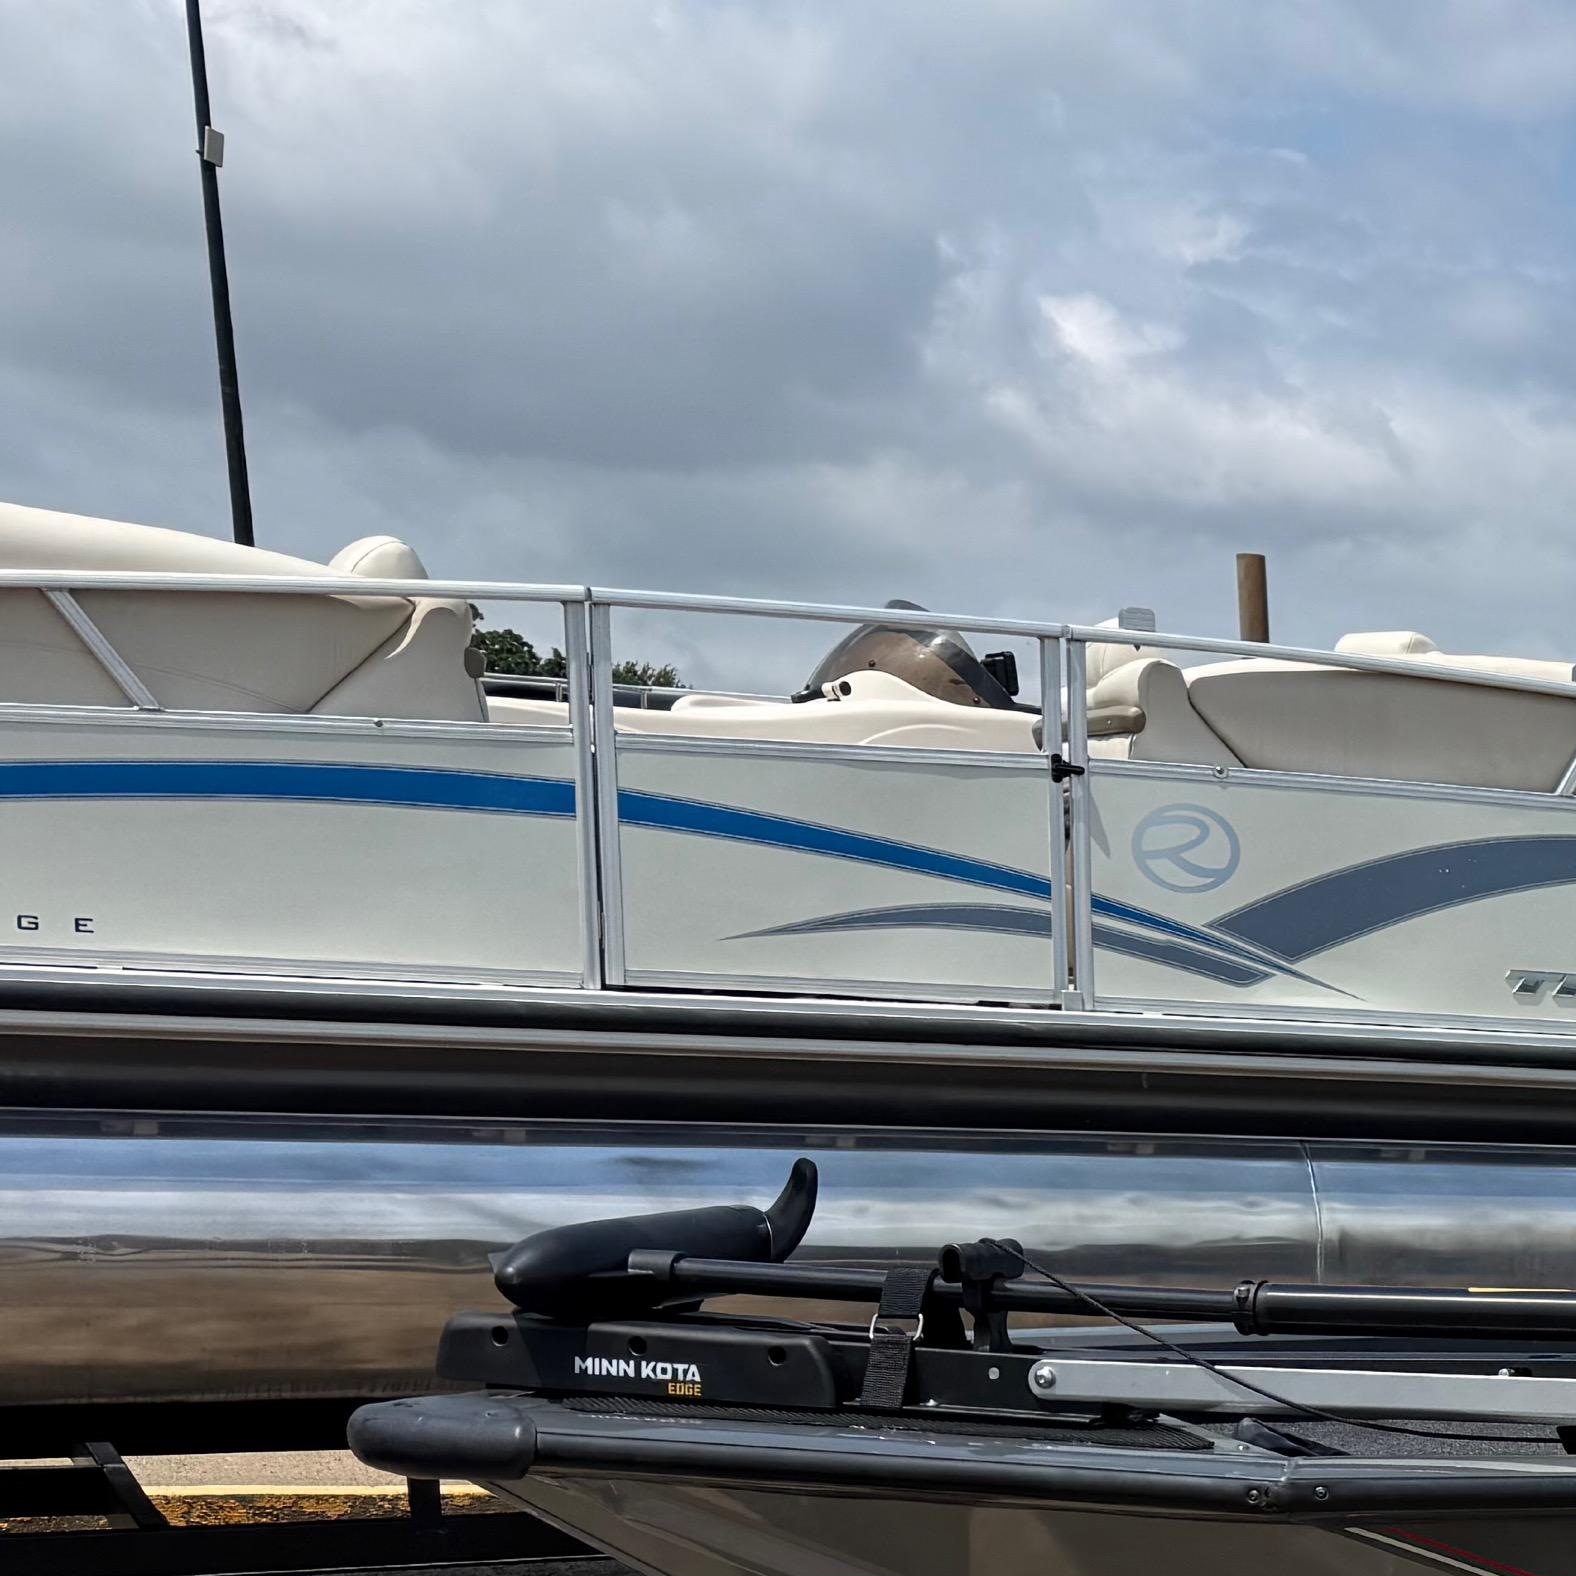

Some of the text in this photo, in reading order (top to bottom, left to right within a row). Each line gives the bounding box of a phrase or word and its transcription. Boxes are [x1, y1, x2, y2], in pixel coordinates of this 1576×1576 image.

[574, 1355, 702, 1382] MINN KOTA
[667, 1382, 702, 1396] EDGE
